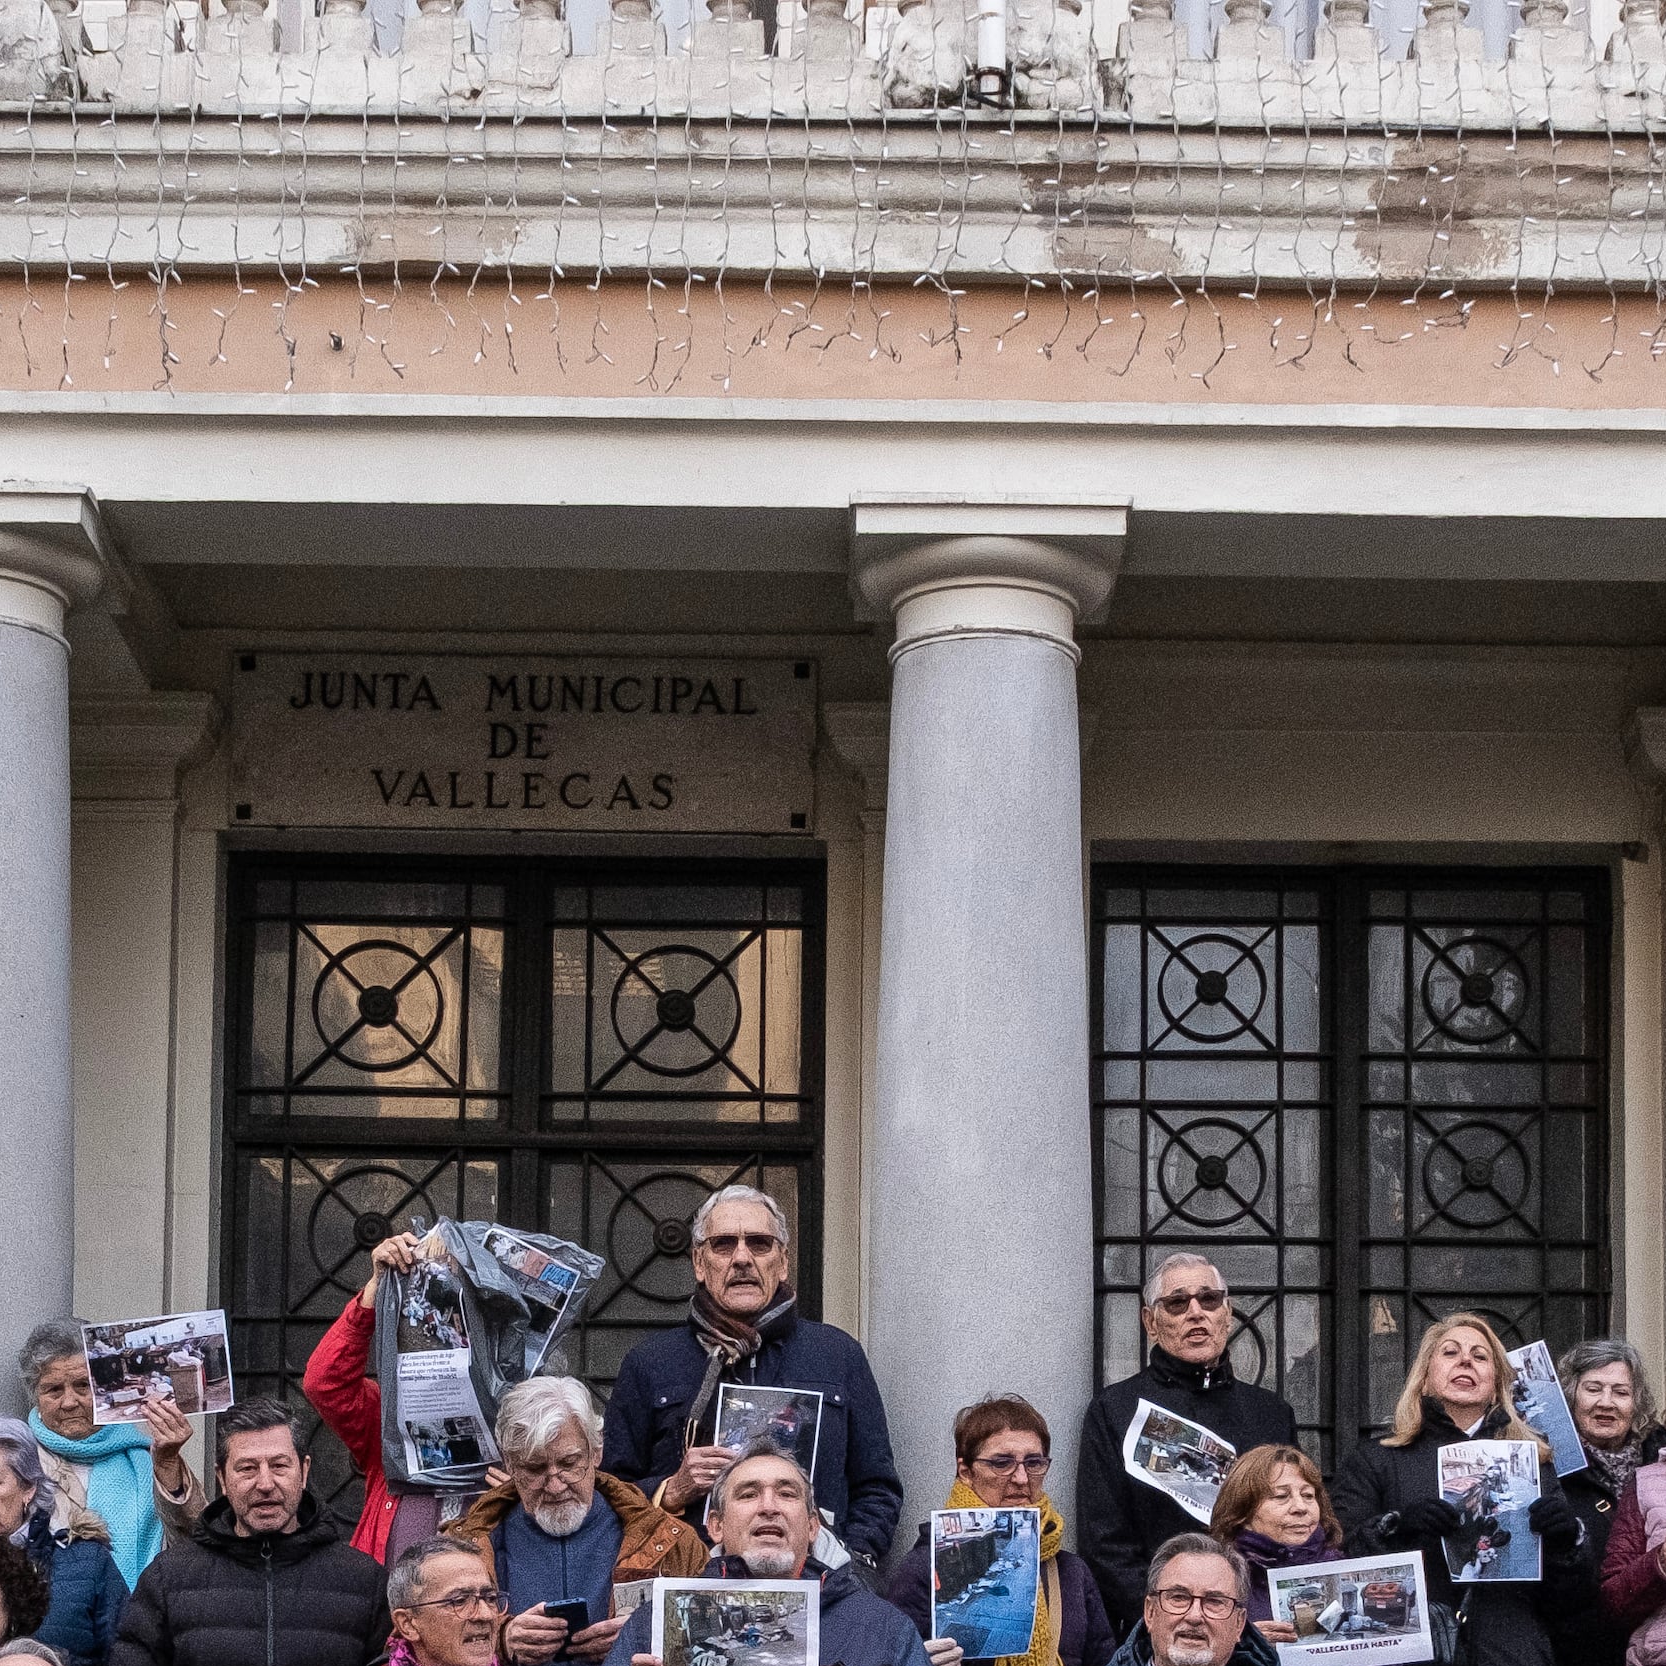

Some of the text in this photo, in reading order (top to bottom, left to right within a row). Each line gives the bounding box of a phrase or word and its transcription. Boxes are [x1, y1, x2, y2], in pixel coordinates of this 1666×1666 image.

[290, 672, 758, 715] JUNTA MUNICIPAL
[487, 722, 550, 760] DE
[371, 769, 677, 810] VALLECAS
